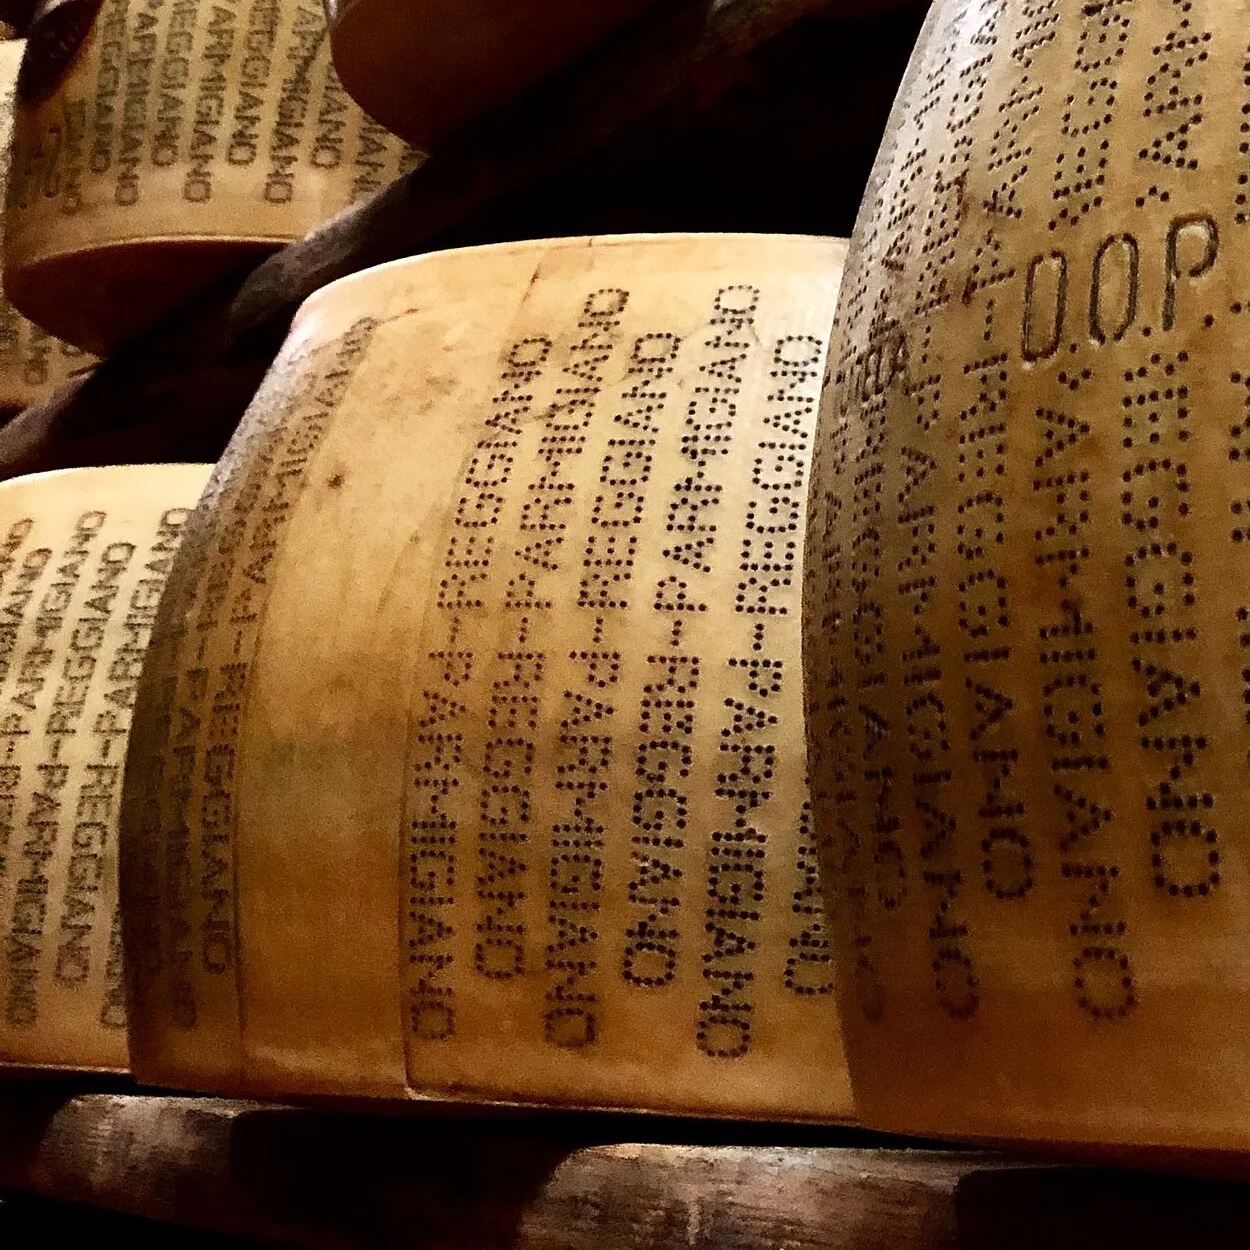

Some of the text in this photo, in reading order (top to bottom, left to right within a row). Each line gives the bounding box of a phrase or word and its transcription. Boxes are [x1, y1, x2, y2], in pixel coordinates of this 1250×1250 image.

[437, 335, 553, 611] REGGIANO
[577, 332, 682, 611] REGGIANO
[734, 335, 823, 615] REGGIANO
[473, 652, 546, 980] REGGIANO
[622, 655, 701, 988] REGGIANO
[696, 658, 783, 1059] PARMIGIANO
